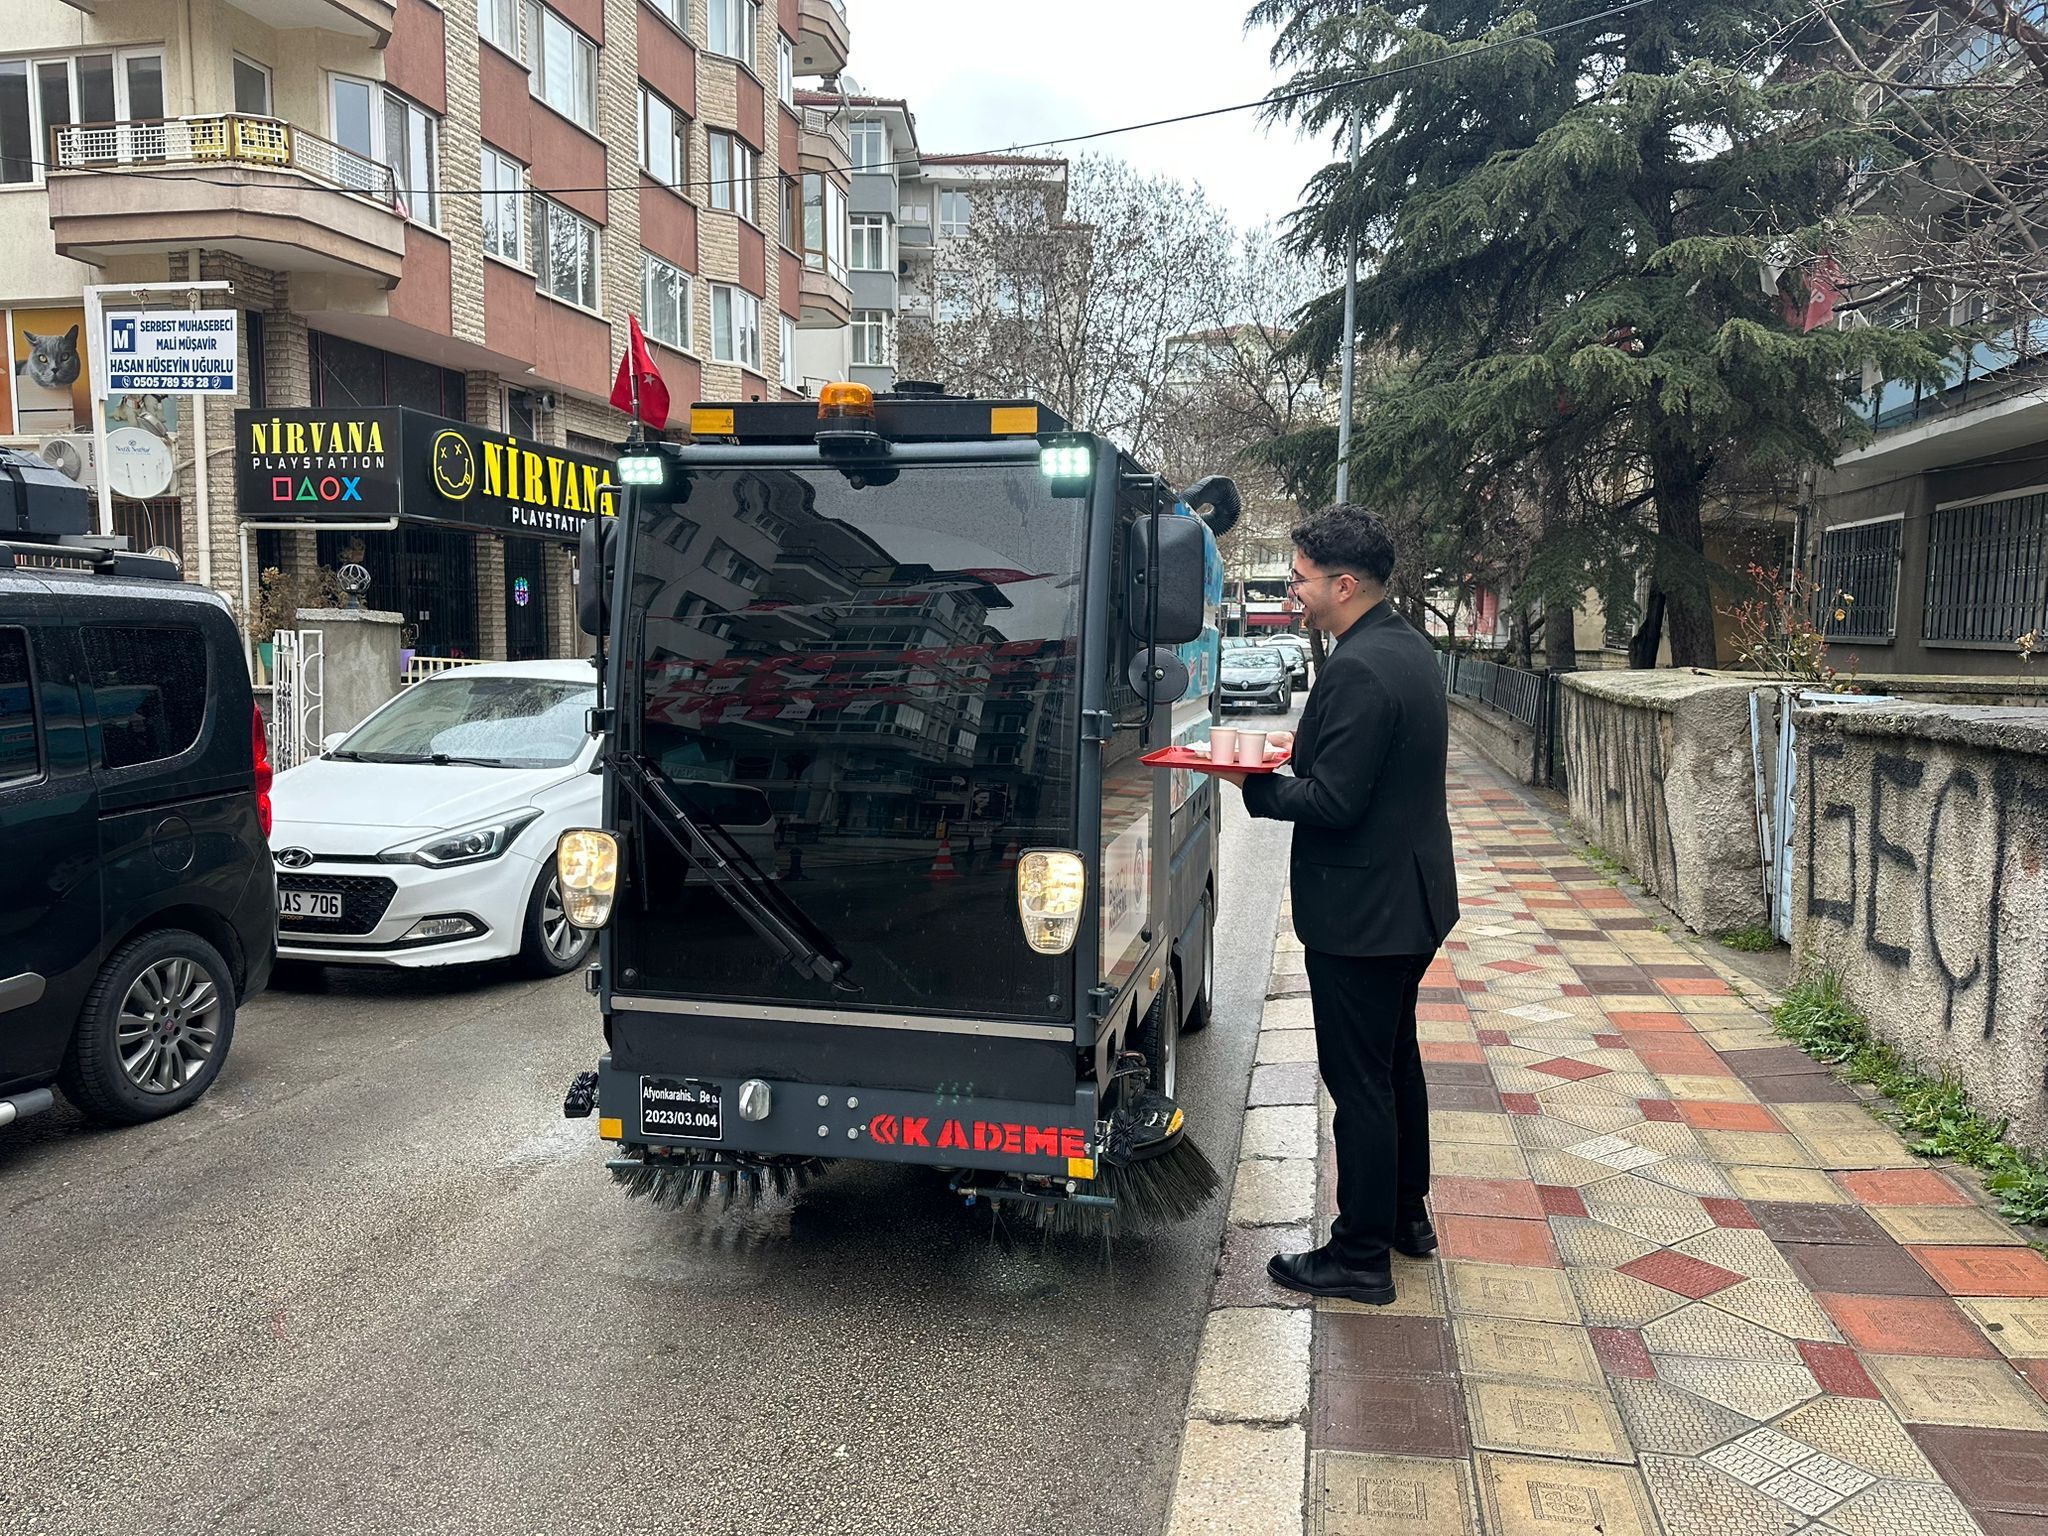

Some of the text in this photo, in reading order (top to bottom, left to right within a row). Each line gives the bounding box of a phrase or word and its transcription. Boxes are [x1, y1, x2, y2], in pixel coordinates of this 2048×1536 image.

[140, 317, 233, 332] SERBEST MUHASEBECİ
[156, 336, 217, 352] MALİ MÜŞAVİR
[110, 356, 234, 373] HASAN HÜSEYİN UĞURLU
[133, 377, 209, 388] 0505 789 36 28
[250, 417, 385, 455] NİRVANA
[253, 455, 384, 470] PLAYSTATION
[279, 892, 339, 915] AS 706
[645, 1109, 718, 1128] 2023/03.004
[902, 1116, 1086, 1159] KADEME
